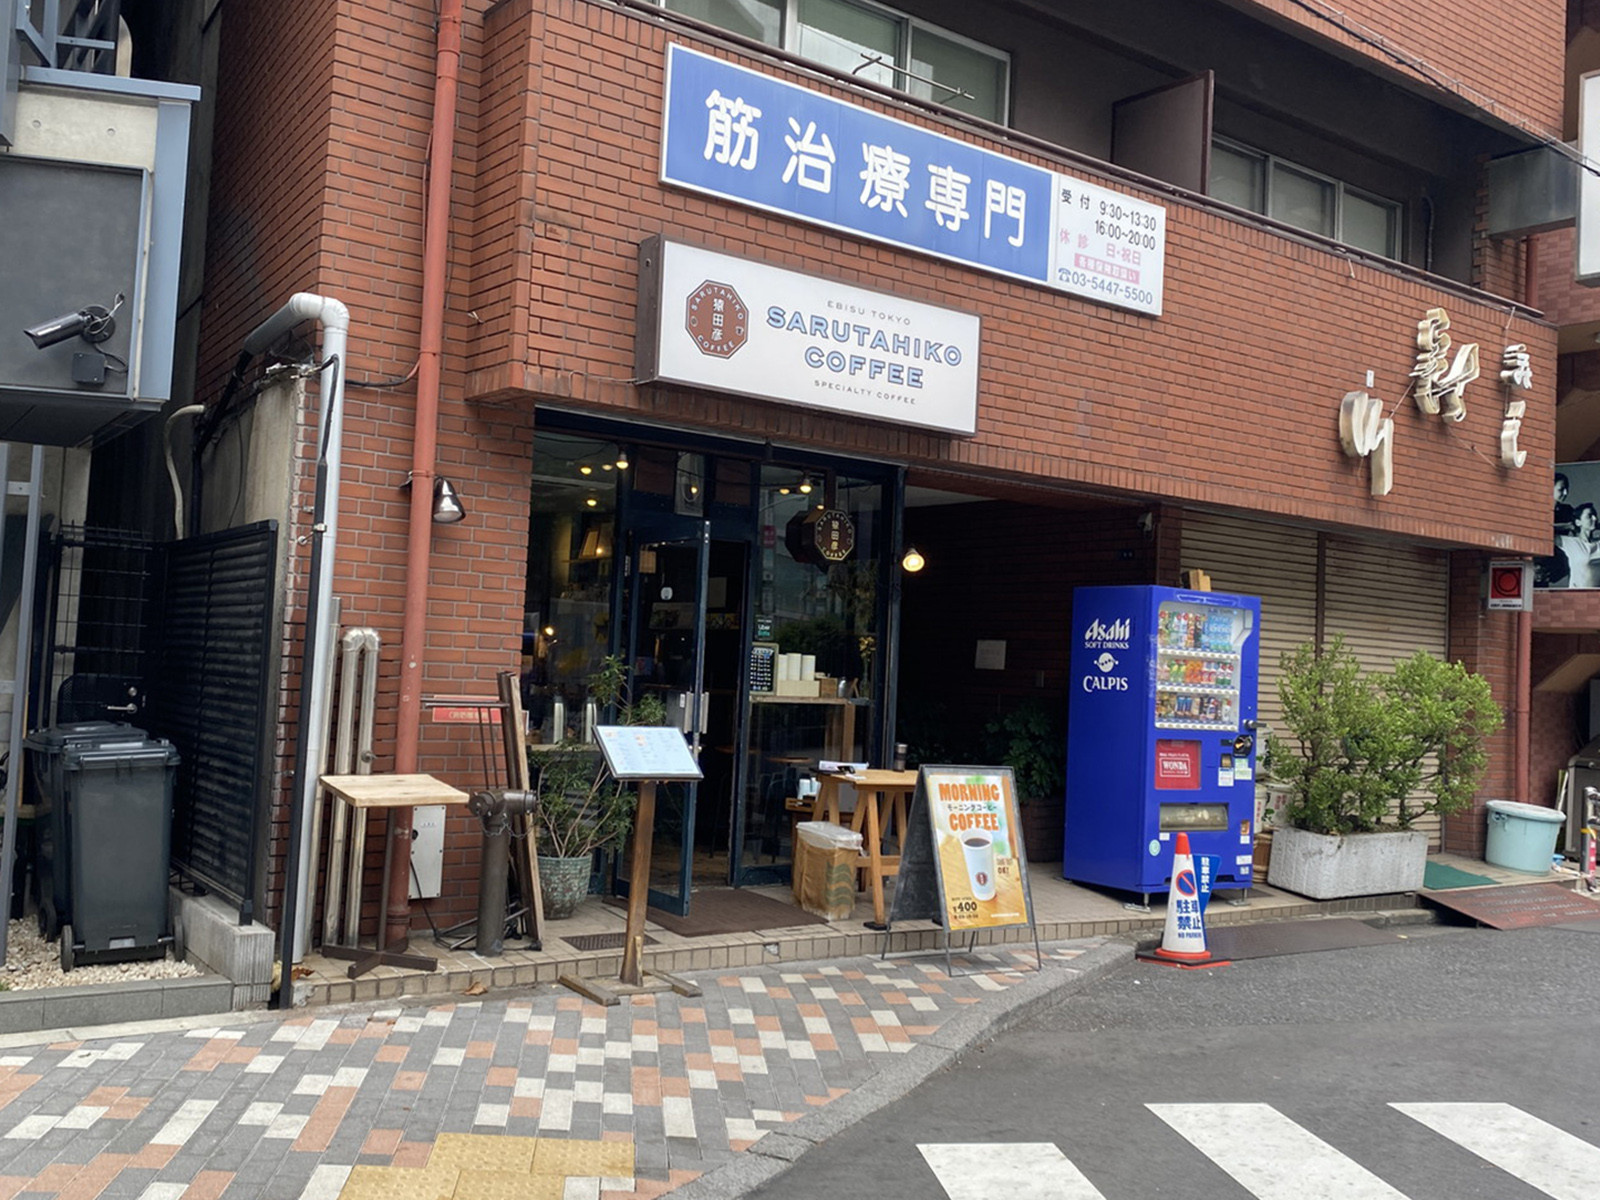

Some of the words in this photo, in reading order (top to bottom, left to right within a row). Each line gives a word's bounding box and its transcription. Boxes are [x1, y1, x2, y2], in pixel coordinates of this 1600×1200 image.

[703, 88, 1026, 248] 筋治療専門
[1061, 188, 1090, 210] 受付
[1071, 271, 1153, 305] 03-5447-5500
[691, 287, 744, 320] SARUTAHIKO
[827, 300, 866, 316] EBISU
[871, 310, 911, 326] TOKYO
[766, 305, 962, 367] SARUTAHIKO
[804, 346, 924, 389] COFFEE
[814, 379, 872, 396] SPECIALTY
[876, 391, 916, 405] COFFEE
[1084, 618, 1131, 641] Asahi
[1084, 641, 1102, 649] SOFT
[1103, 641, 1130, 650] DRINKS
[1083, 675, 1129, 693] CALPIS
[938, 783, 1000, 802] MORNING
[949, 813, 1000, 832] COFFEE
[1176, 899, 1199, 914] 駐車
[1177, 915, 1202, 930] 禁止
